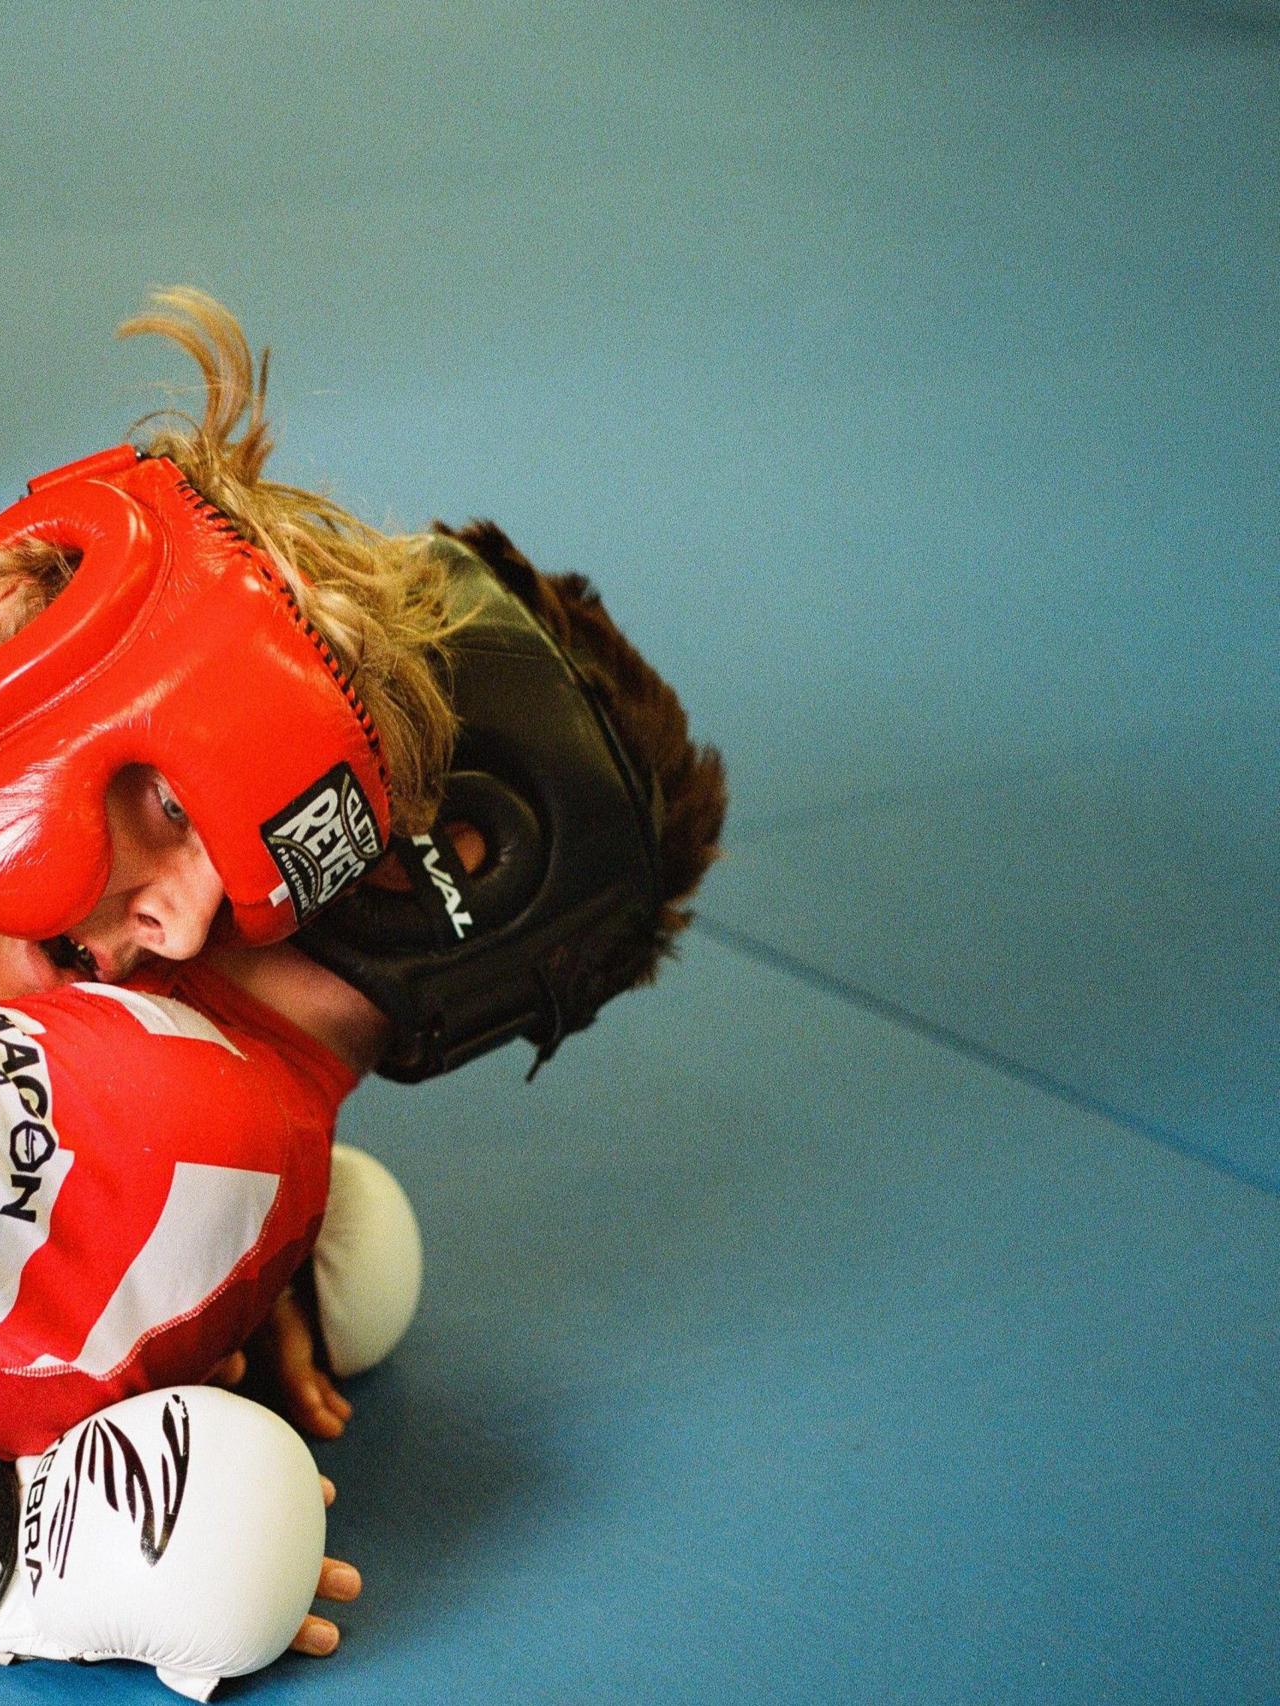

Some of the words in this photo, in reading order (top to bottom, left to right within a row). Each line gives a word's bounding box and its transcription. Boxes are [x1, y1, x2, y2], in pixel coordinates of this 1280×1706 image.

[273, 787, 366, 903] REYES
[346, 787, 378, 854] CLETO
[410, 833, 474, 939] IVAL
[24, 1436, 64, 1598] EBRA
